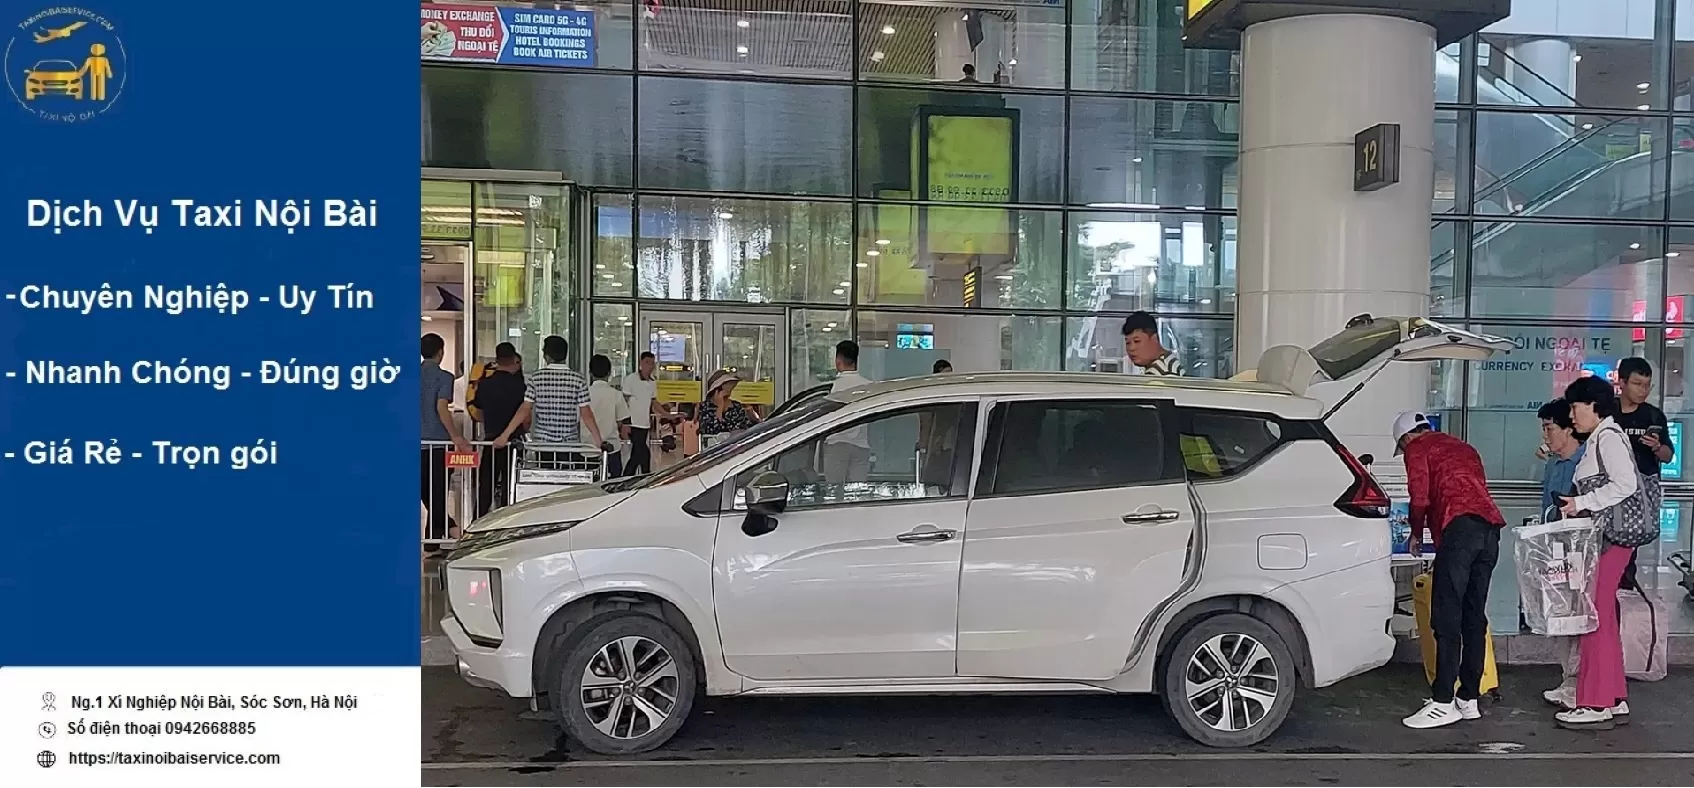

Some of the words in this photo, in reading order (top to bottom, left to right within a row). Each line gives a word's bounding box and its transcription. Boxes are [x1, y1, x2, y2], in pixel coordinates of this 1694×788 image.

[449, 11, 495, 22] EXCHANGE
[514, 13, 531, 23] SIM
[533, 15, 555, 25] CARD
[557, 15, 569, 25] 5G
[460, 26, 477, 37] THU
[509, 24, 537, 35] TOURIS
[538, 27, 592, 37] INFORMATION
[457, 41, 486, 53] NGOẠI
[515, 37, 541, 46] HOTEL
[543, 39, 585, 48] BOOKINGS
[513, 49, 536, 58] BOOK
[538, 50, 552, 59] AIR
[554, 51, 588, 60] TICKETS
[1363, 139, 1377, 172] 12
[1474, 361, 1534, 372] CURRENCY
